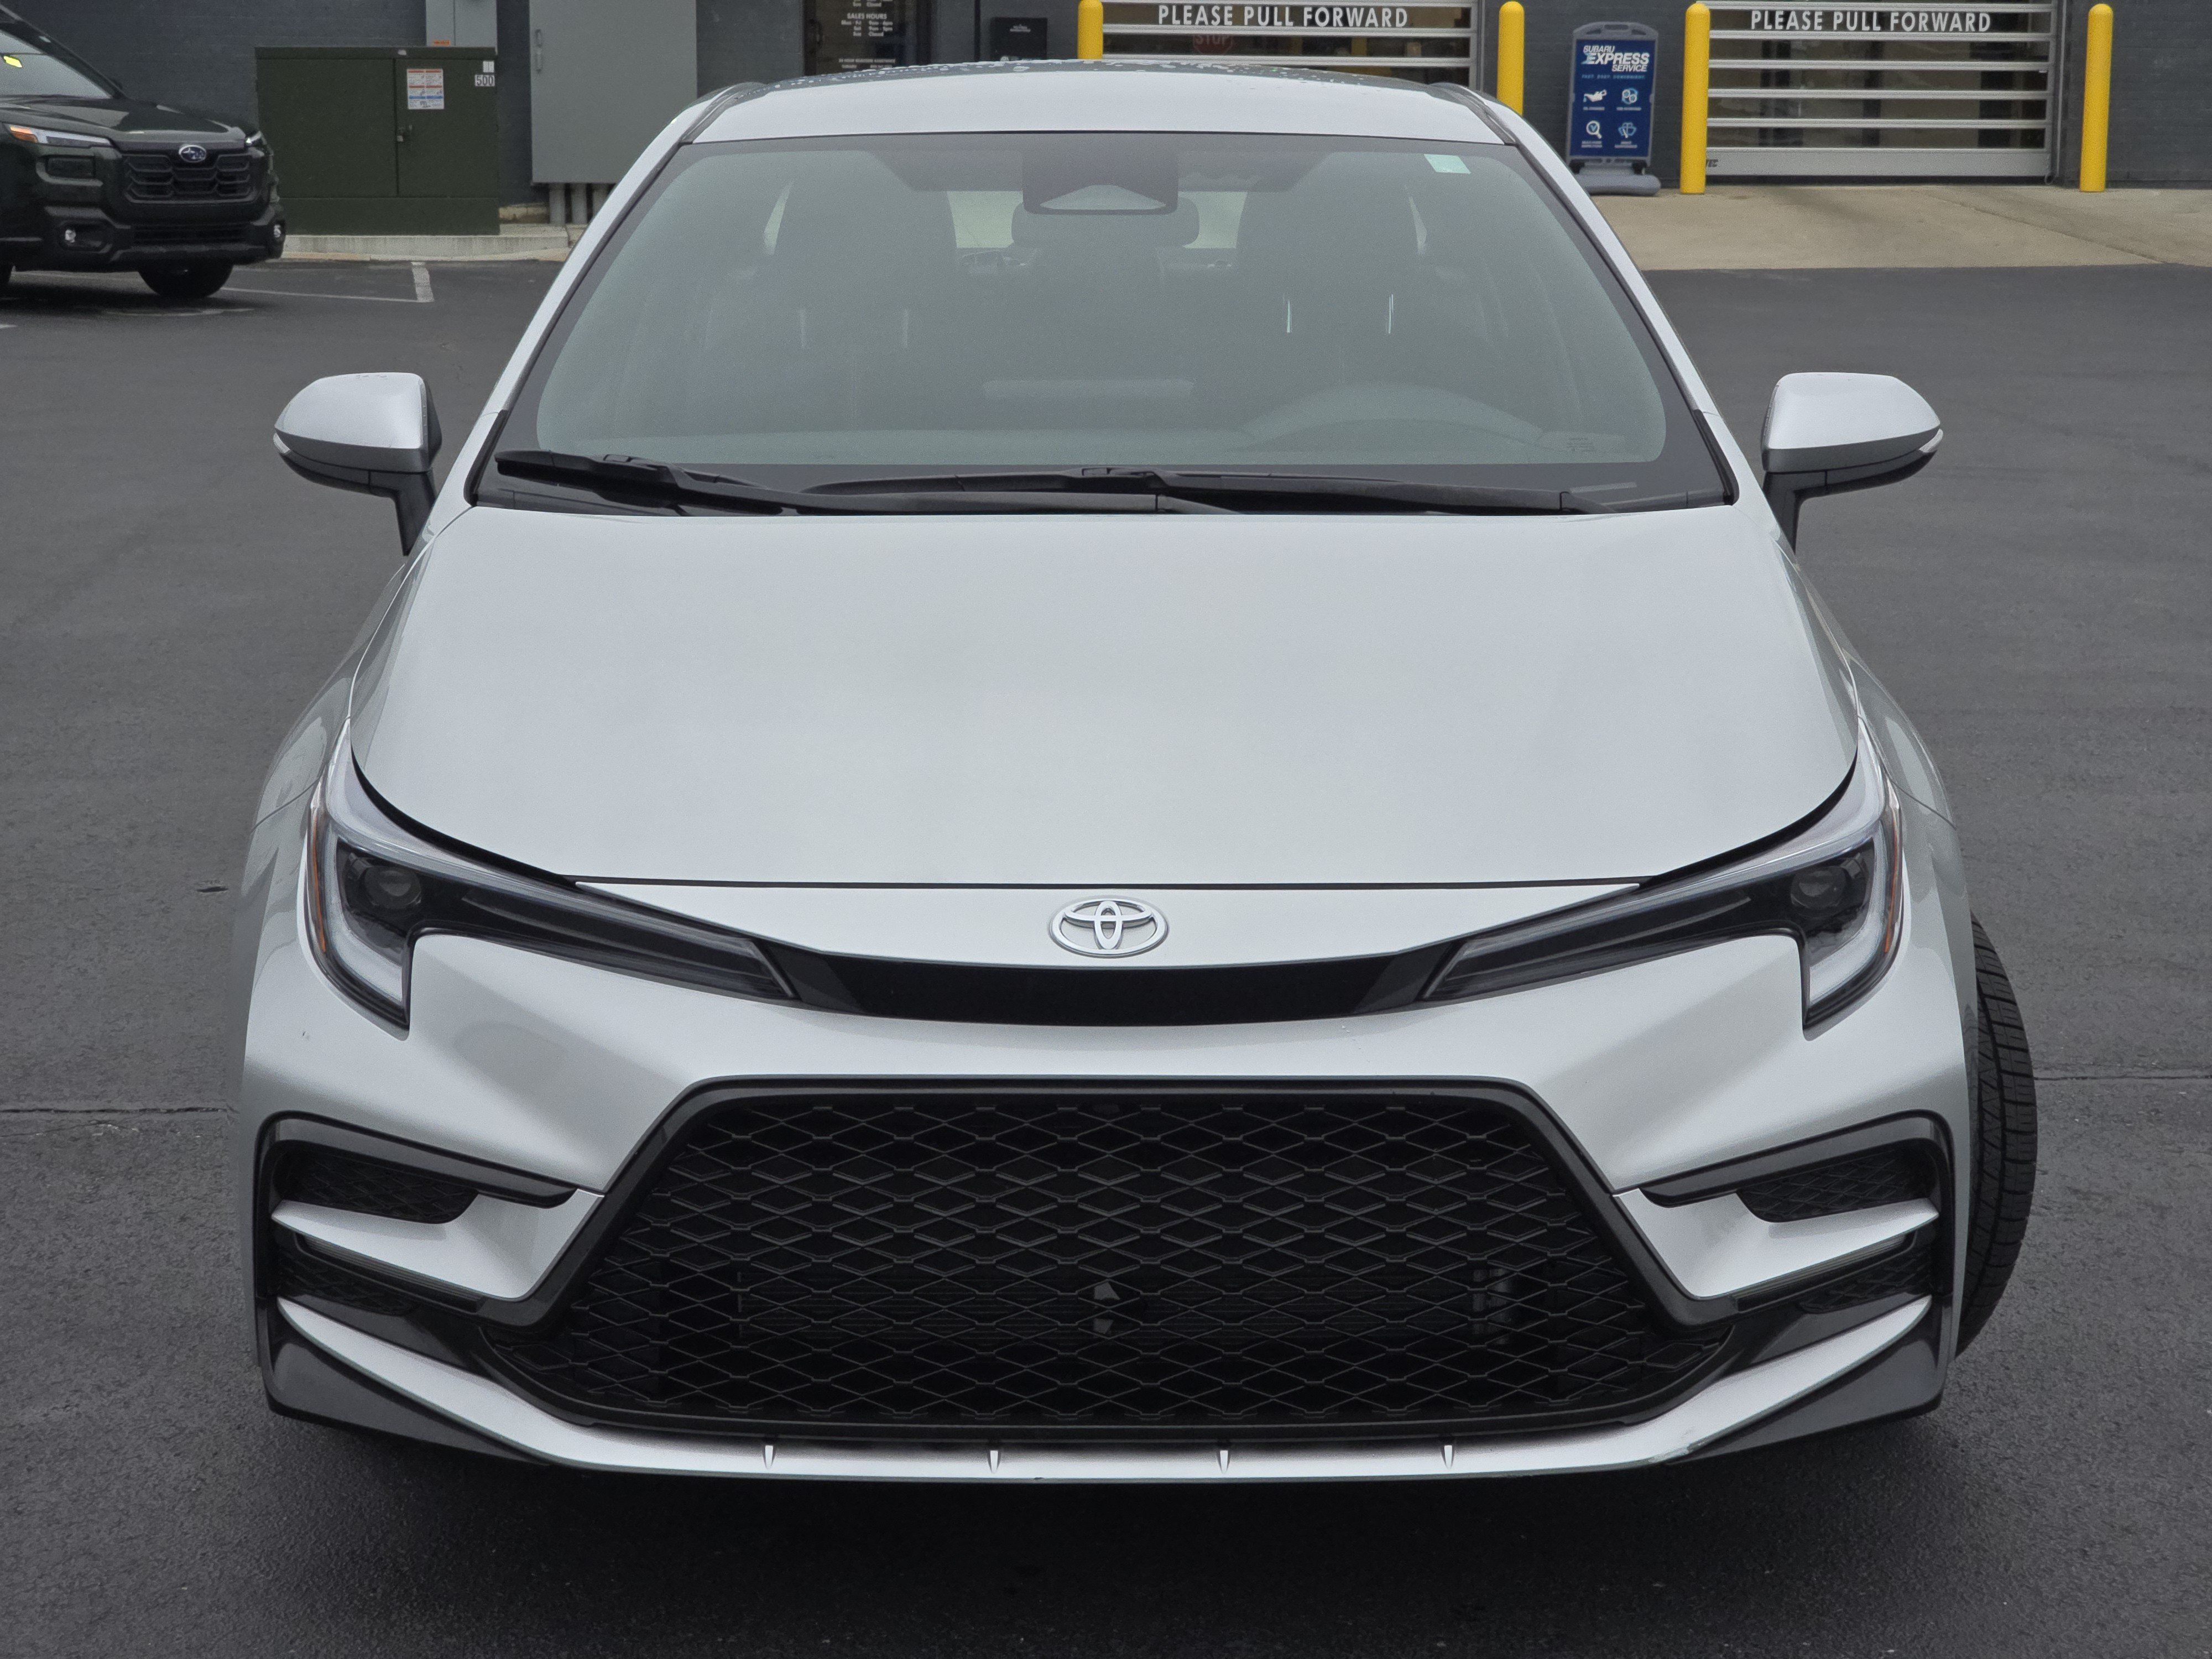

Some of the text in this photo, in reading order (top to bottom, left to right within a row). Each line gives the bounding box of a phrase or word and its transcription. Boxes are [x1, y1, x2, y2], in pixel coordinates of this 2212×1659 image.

[1159, 5, 1407, 28] PLEASE PULL FORWARD
[1751, 11, 1990, 32] PLEASE PULL FORWARD
[1583, 45, 1615, 54] SUBARU
[1582, 53, 1650, 65] EXPRESS
[477, 75, 494, 86] 500
